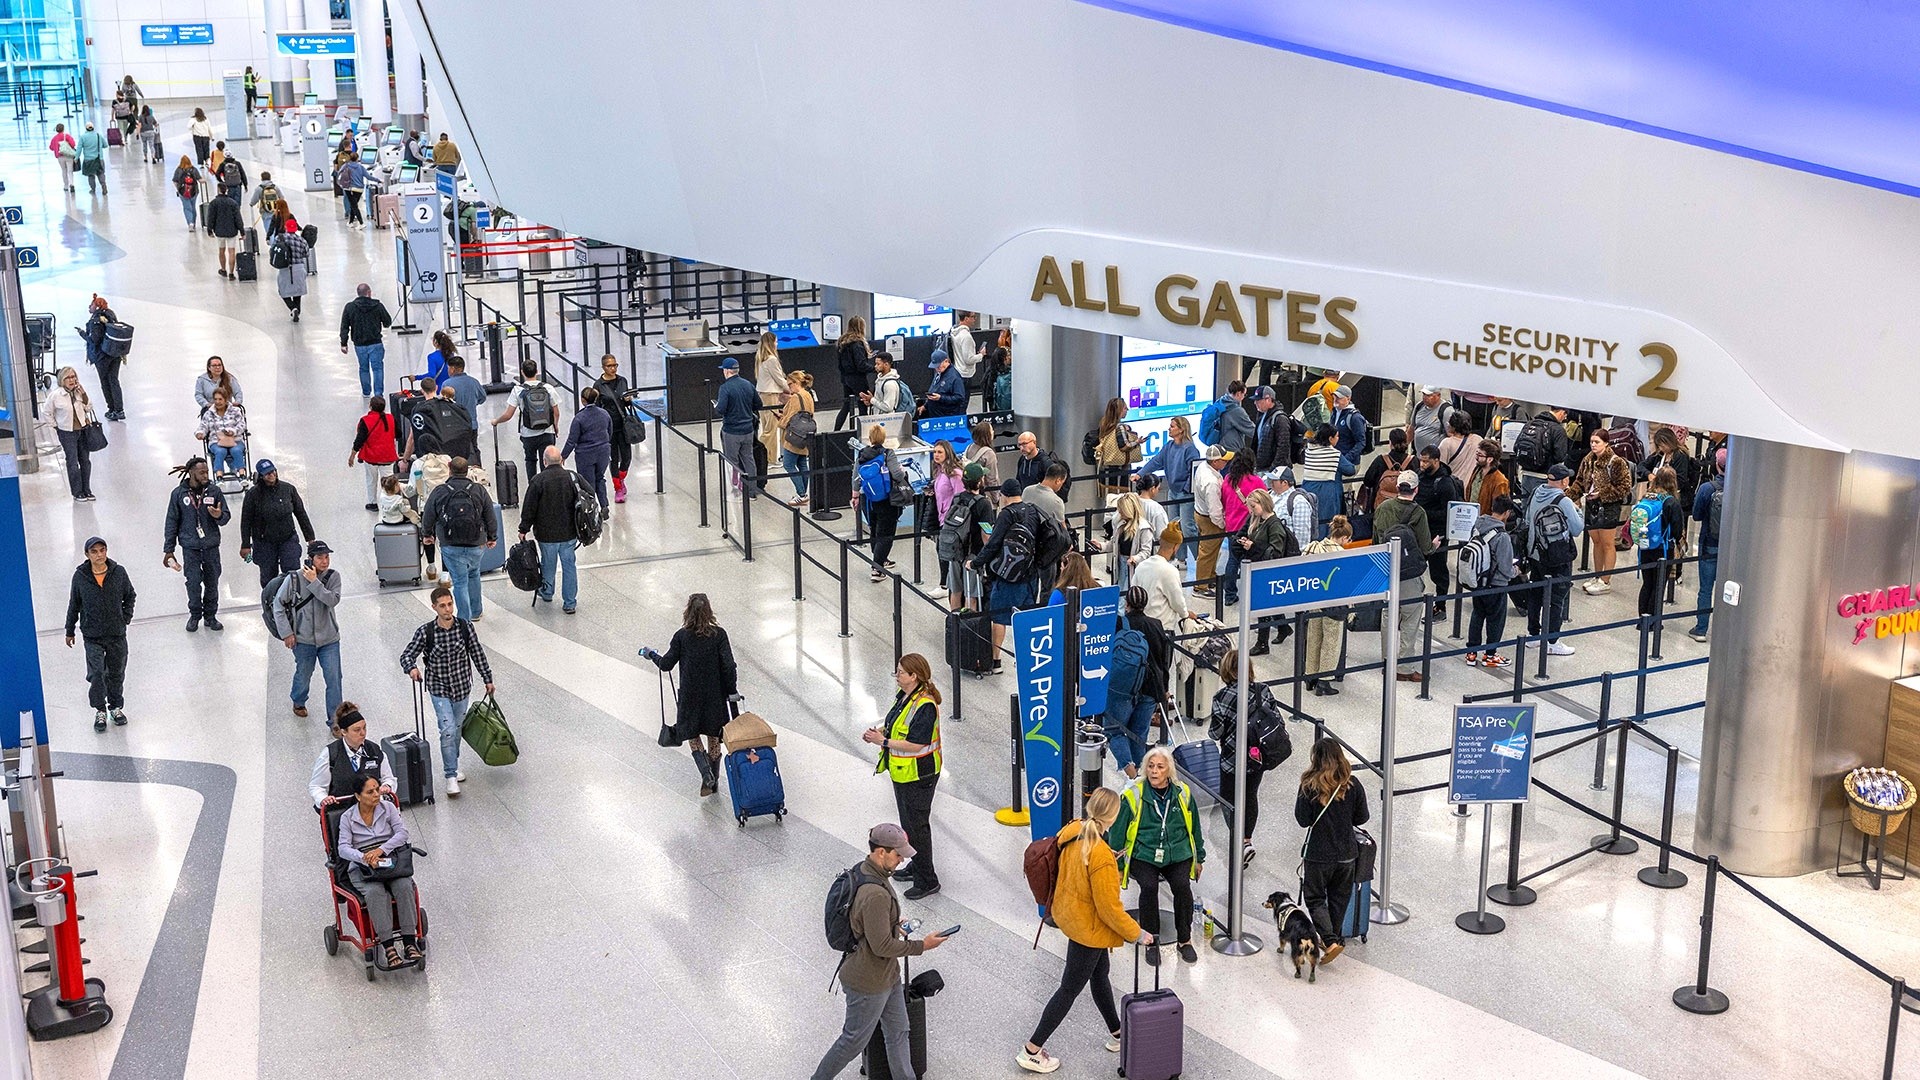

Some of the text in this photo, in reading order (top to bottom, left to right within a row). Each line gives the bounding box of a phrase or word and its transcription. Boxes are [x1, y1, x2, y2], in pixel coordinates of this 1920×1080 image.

[311, 123, 316, 132] 1
[419, 207, 428, 220] 2
[1030, 255, 1359, 351] ALL GATES
[1482, 322, 1620, 362] SECURITY
[1148, 363, 1188, 373] travel lighter
[1432, 340, 1618, 386] CHECKPOINT
[1636, 341, 1679, 403] 2
[1268, 576, 1320, 596] TSA Pre
[1837, 582, 1920, 618] CHARL
[1875, 609, 1920, 639] DUN
[1083, 633, 1112, 645] Enter
[1085, 645, 1110, 657] Here
[1029, 618, 1053, 722] TSA Pre
[1458, 716, 1507, 728] TSA Pre
